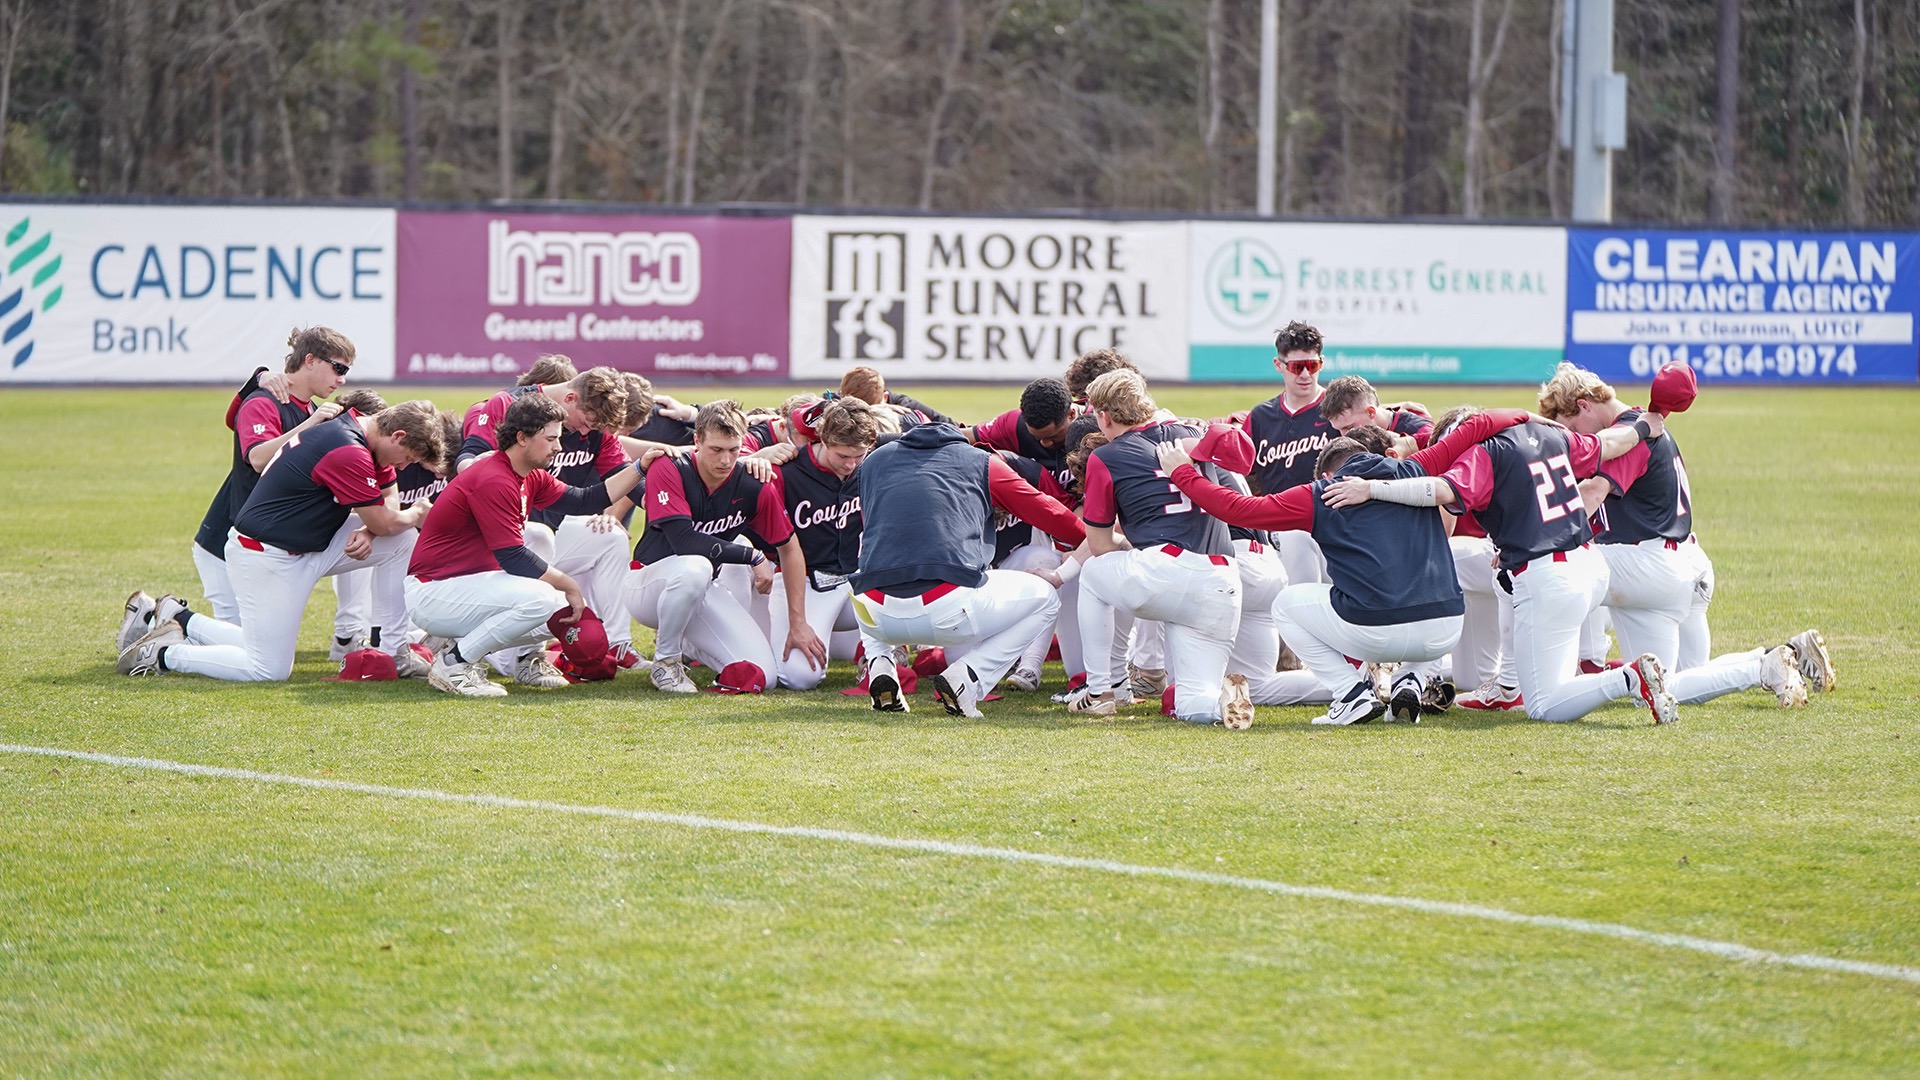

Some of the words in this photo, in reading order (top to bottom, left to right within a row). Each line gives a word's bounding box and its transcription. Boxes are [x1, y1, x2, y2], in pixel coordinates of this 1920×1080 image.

[488, 219, 701, 306] hanco
[927, 233, 1126, 272] MOORE
[1593, 237, 1897, 283] CLEARMAN
[90, 245, 383, 300] CADENCE
[924, 279, 1156, 318] FUNERAL
[1296, 297, 1420, 315] HOSPITAL
[1596, 283, 1766, 311] INSURANCE
[1772, 284, 1892, 312] AGENCY
[93, 317, 190, 353] Bank
[484, 312, 577, 341] General
[579, 313, 704, 341] Contractors
[925, 323, 1128, 361] SERVICE
[1624, 320, 1670, 336] John
[408, 353, 424, 373] A
[425, 353, 491, 373] Hudson
[1629, 344, 1857, 377] 601-264-9974
[1256, 432, 1333, 469] Cougars
[399, 476, 449, 504] ougars
[1528, 453, 1585, 523] 23
[794, 496, 861, 530] Couga
